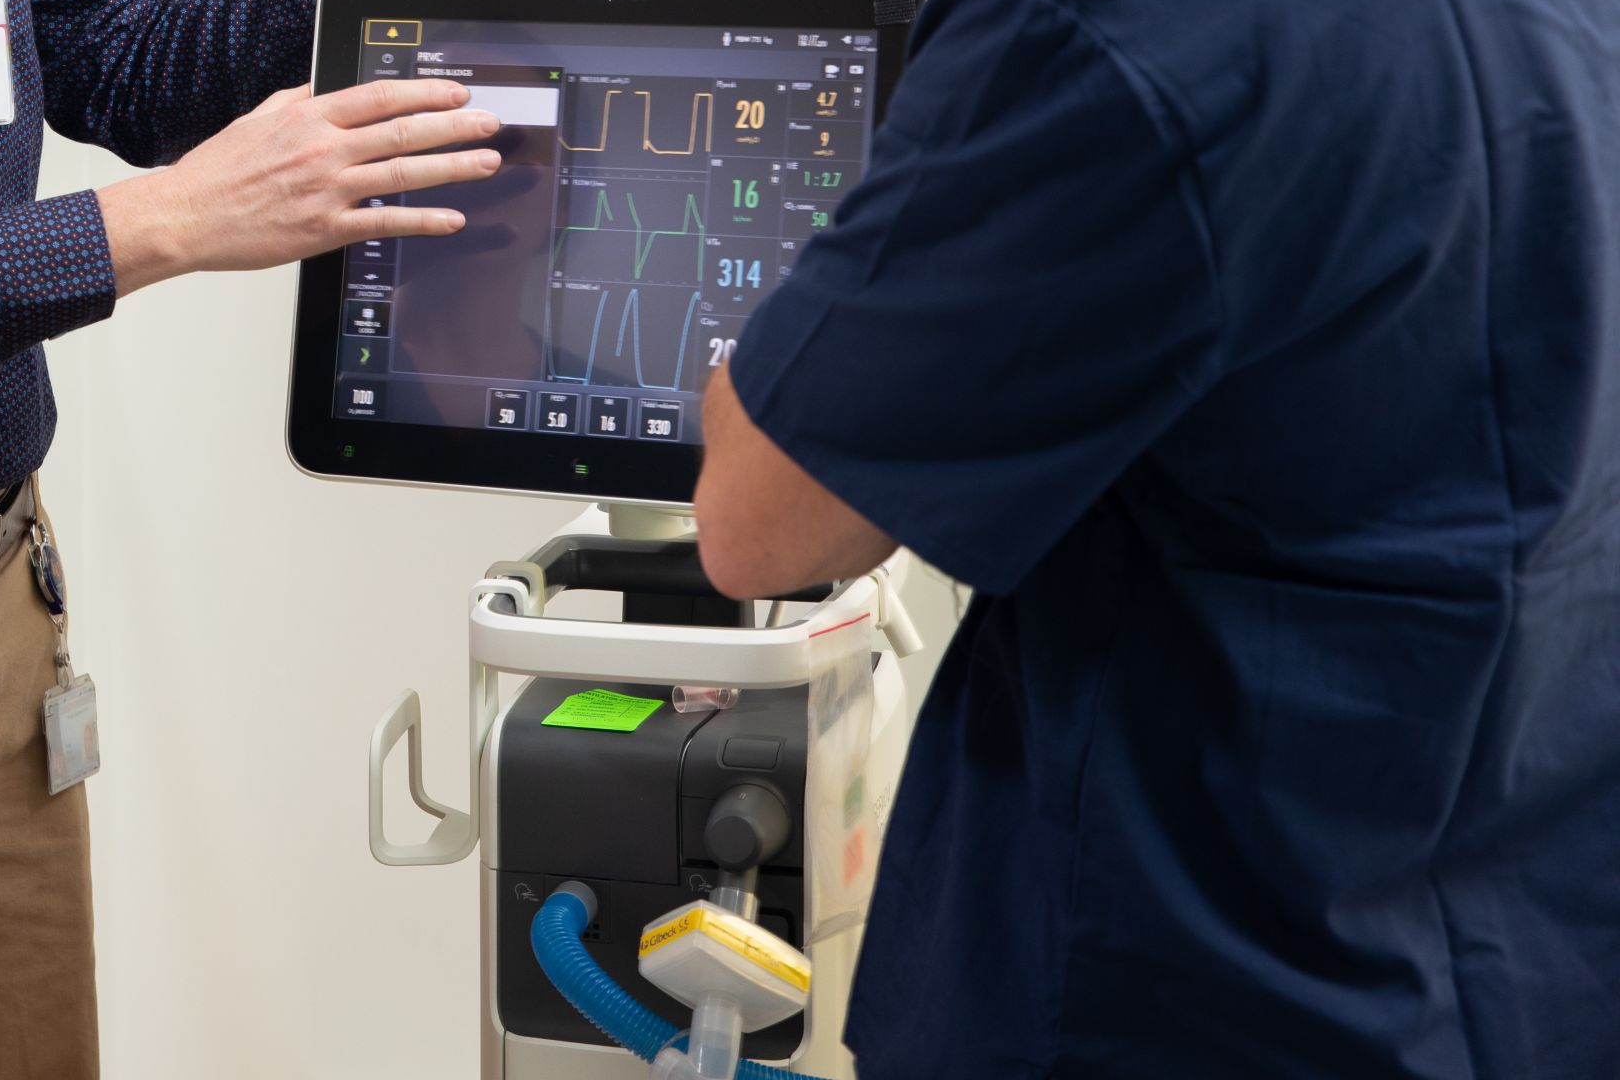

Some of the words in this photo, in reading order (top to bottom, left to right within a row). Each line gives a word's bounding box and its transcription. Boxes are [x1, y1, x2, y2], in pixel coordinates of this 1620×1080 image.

[735, 100, 765, 129] 20
[820, 132, 829, 146] 9
[733, 179, 759, 208] 16
[812, 212, 828, 227] 50
[717, 258, 761, 288] 314
[498, 408, 515, 424] 50
[601, 415, 616, 432] 16
[647, 419, 671, 436] 330
